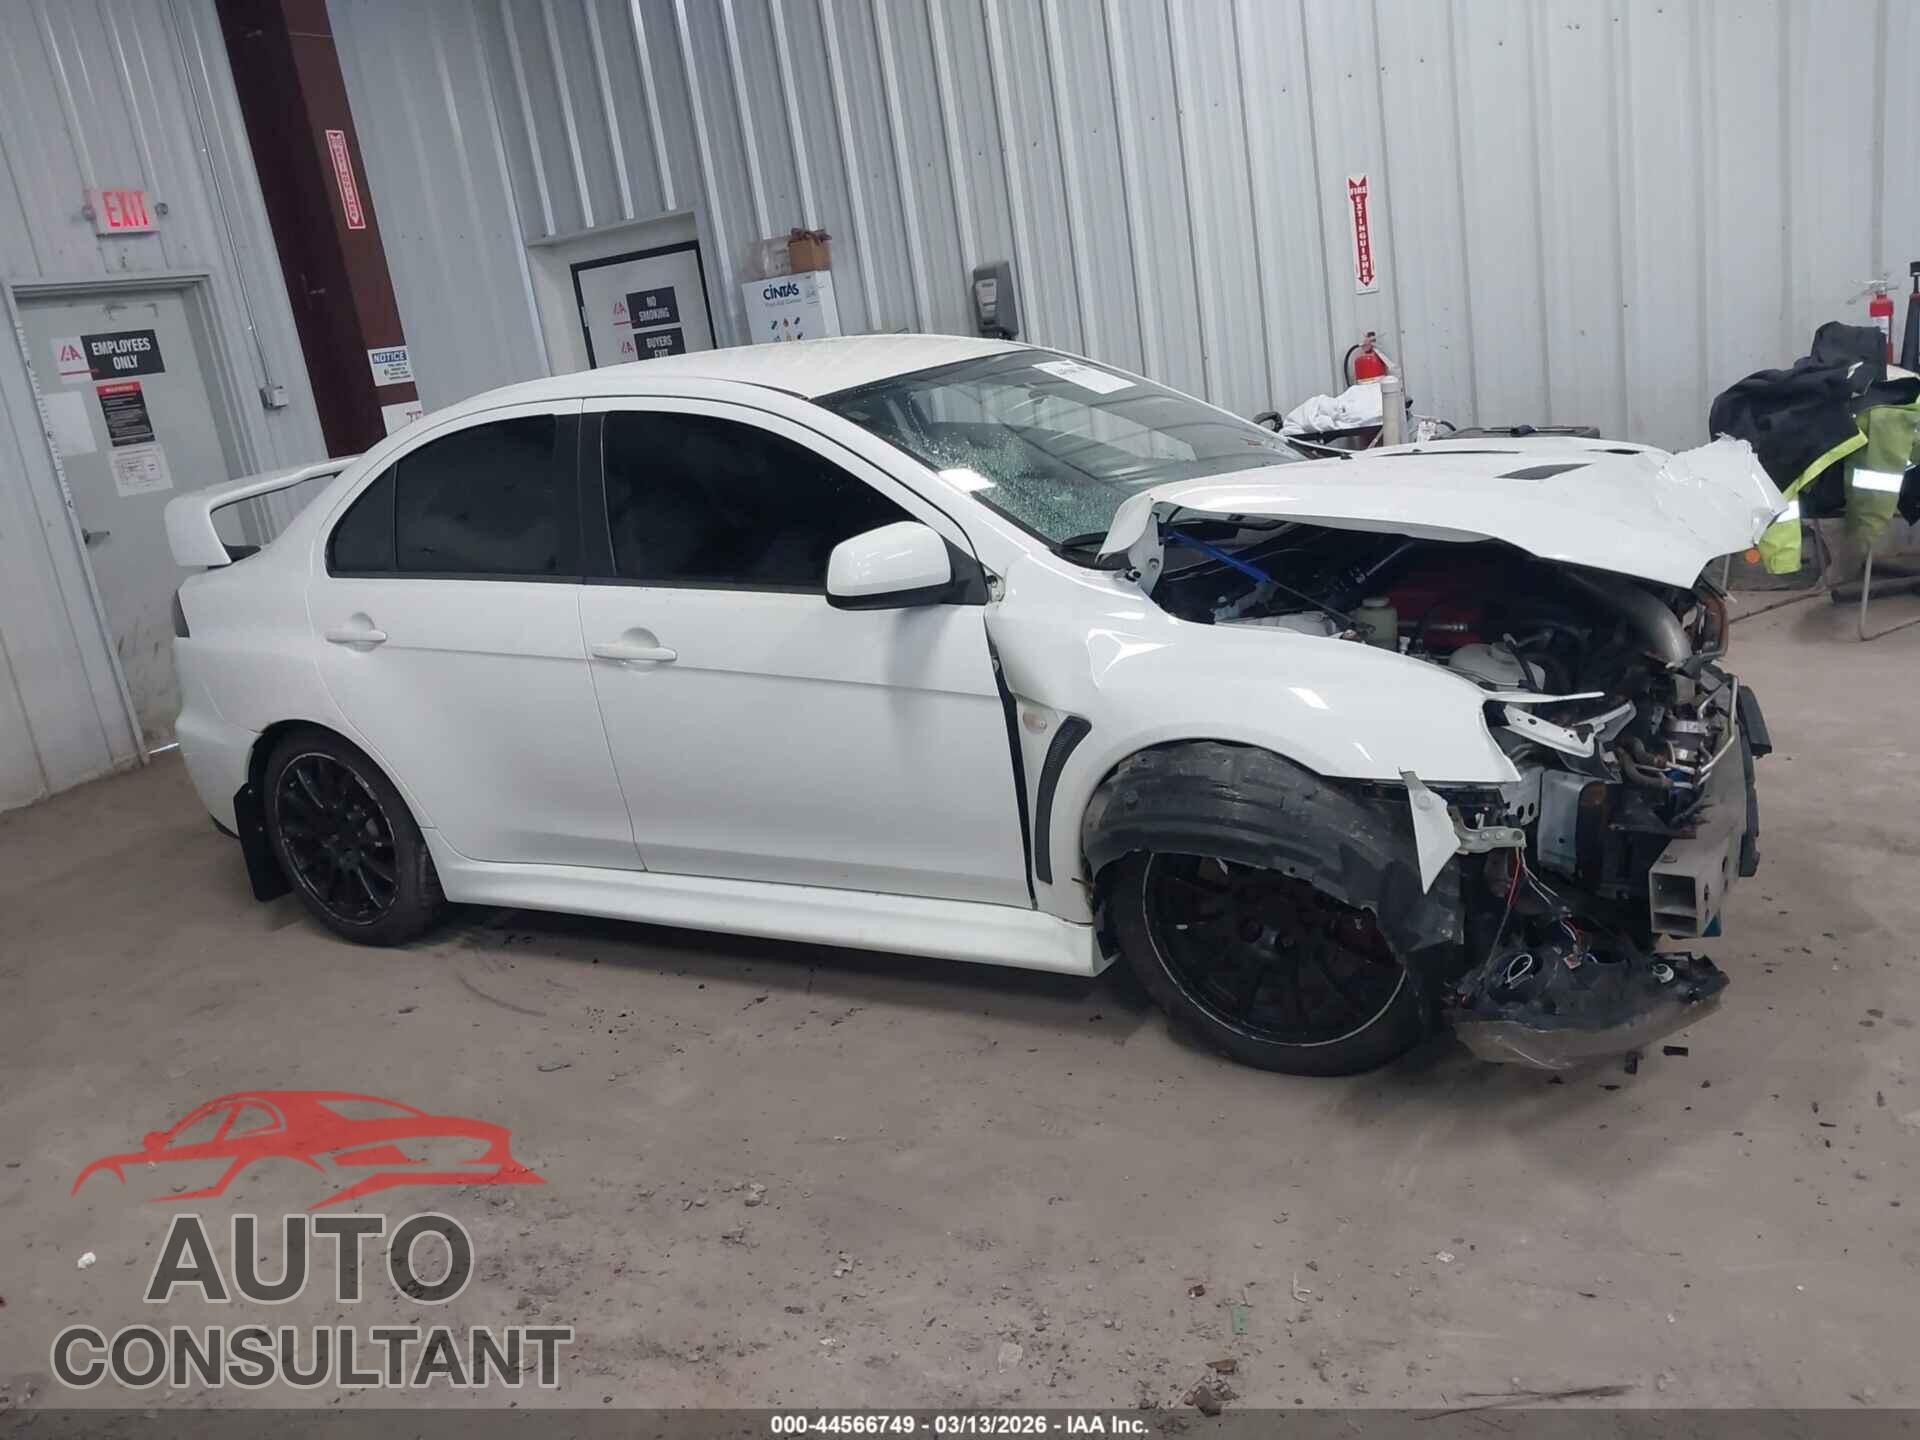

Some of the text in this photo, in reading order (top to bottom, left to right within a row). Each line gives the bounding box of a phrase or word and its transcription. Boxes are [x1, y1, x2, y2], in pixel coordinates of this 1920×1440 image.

[102, 190, 149, 228] EXIT
[1355, 195, 1370, 282] EXTINGUISHER
[762, 282, 800, 301] CINTAS
[638, 307, 670, 322] SMOKING
[91, 337, 152, 356] EMPLOYEES
[646, 335, 673, 349] BUYERS
[112, 354, 139, 370] ONLY
[373, 351, 405, 363] NOTICE
